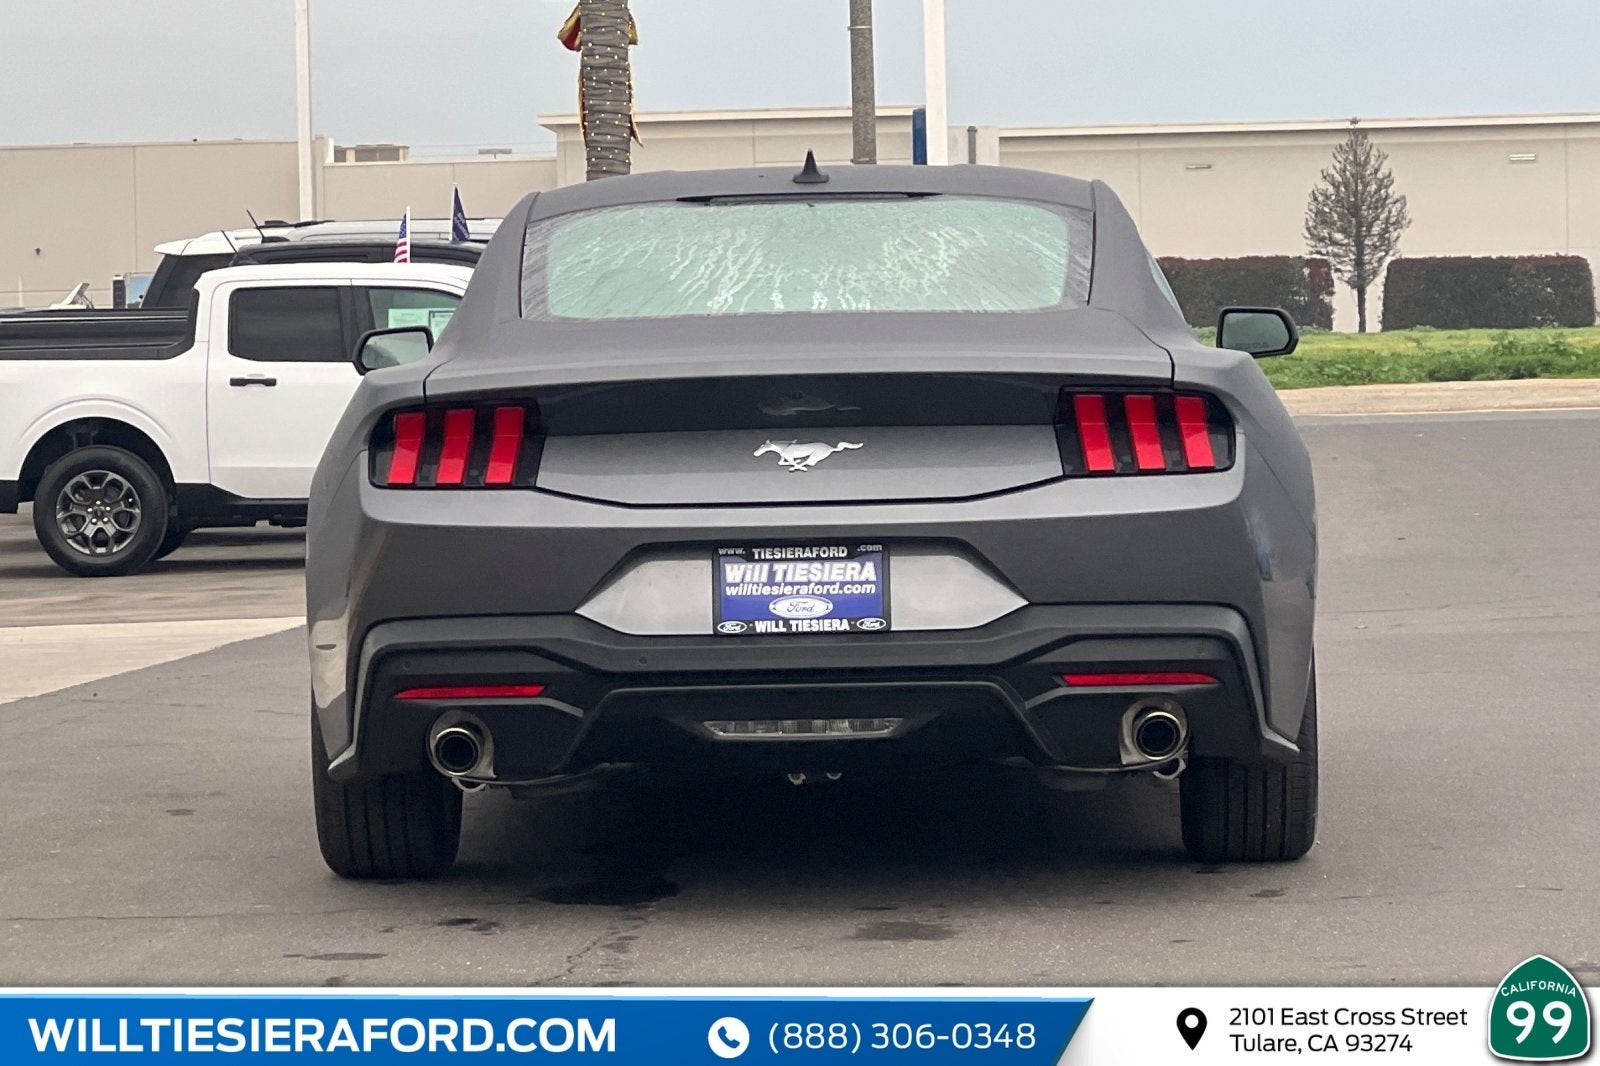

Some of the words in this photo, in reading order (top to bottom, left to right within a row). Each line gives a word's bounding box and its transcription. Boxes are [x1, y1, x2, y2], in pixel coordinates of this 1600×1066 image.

[752, 546, 848, 560] TIESIERAFORD
[857, 544, 883, 552] .com
[724, 562, 770, 584] Will
[772, 561, 877, 583] TIESIERA
[725, 583, 876, 596] willtiesieraford.com
[786, 601, 816, 614] Ford
[722, 622, 742, 632] Ford
[754, 620, 787, 633] WILL
[789, 618, 850, 632] TIESIERA
[861, 619, 882, 629] Ford
